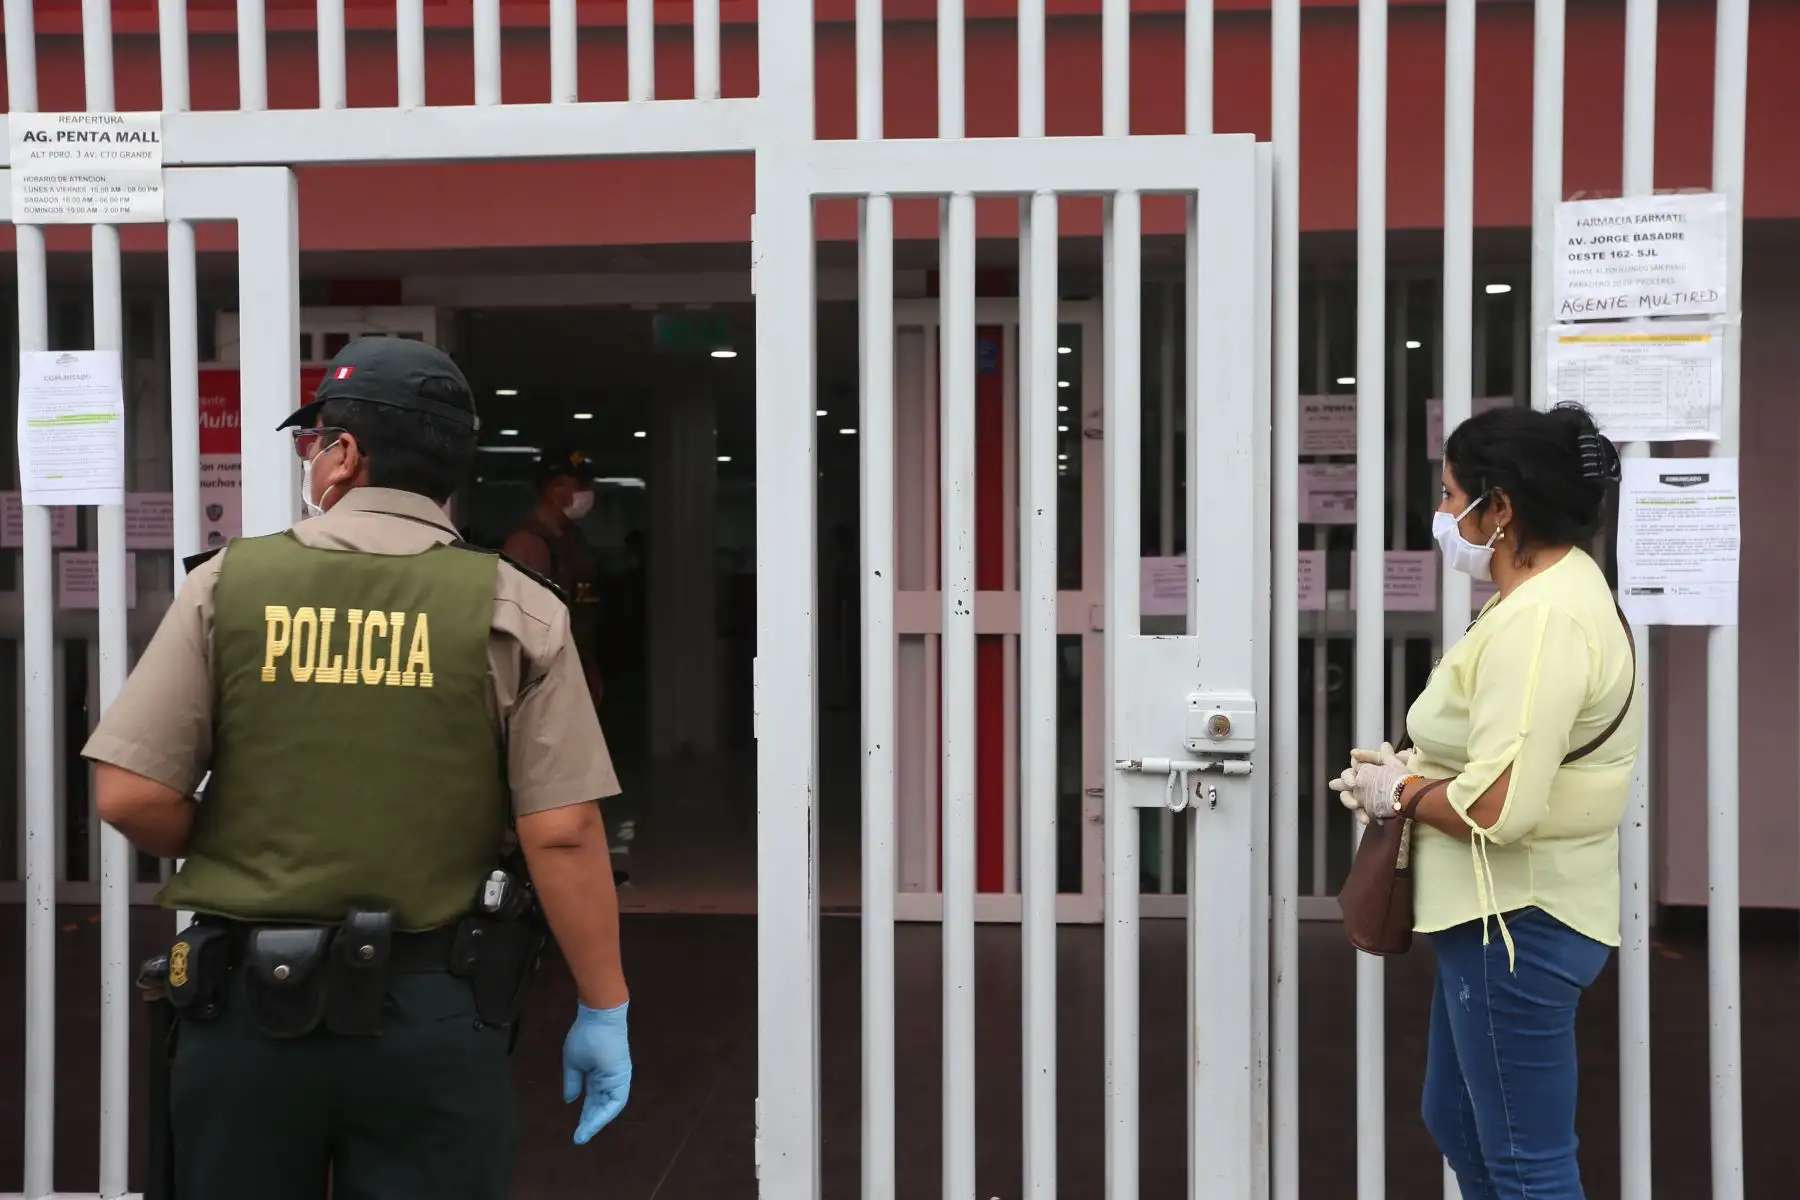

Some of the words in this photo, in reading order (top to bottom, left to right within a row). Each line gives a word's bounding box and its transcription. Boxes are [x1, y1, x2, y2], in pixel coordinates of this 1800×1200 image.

[58, 115, 124, 125] REAPERTURA
[23, 130, 53, 142] AG.
[56, 130, 111, 143] PENTA
[115, 131, 160, 143] MALL
[119, 151, 153, 160] GRANDE
[1576, 215, 1633, 227] FARMACIA
[1568, 236, 1587, 246] AV.
[1590, 234, 1630, 244] JORGE
[1632, 231, 1686, 242] BASADRE
[1567, 251, 1606, 261] OESTE
[1636, 248, 1659, 258] SJL
[1560, 294, 1629, 315] AGENTE
[1638, 289, 1719, 309] MULTIRED
[261, 605, 434, 688] POLICIA
